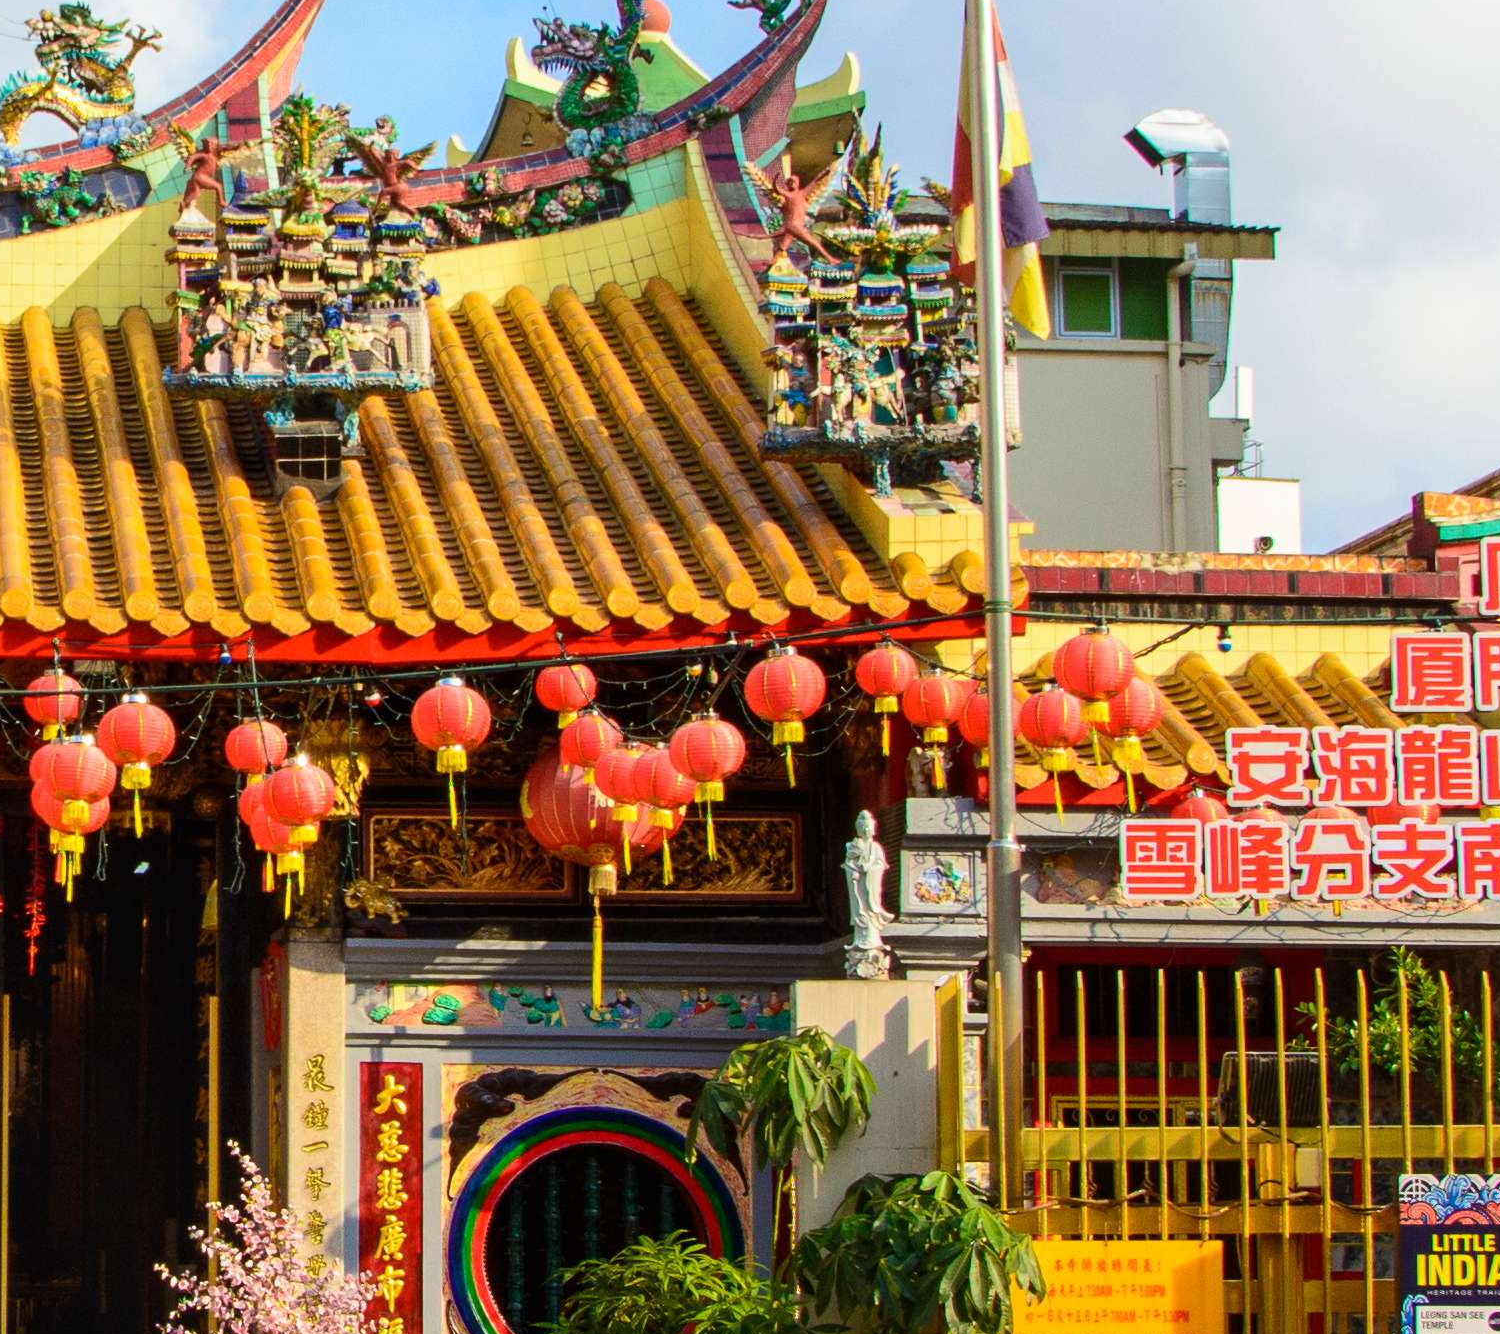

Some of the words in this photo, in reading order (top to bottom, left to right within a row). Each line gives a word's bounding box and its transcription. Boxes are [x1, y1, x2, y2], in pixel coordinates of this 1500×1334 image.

[1431, 1233, 1497, 1252] LITTLE
[1426, 1289, 1473, 1297] HERITAGE
[1420, 1310, 1448, 1320] LEONG
[1449, 1310, 1468, 1319] SAN
[1468, 1310, 1485, 1319] SEE
[1421, 1320, 1454, 1330] TEMPLE
